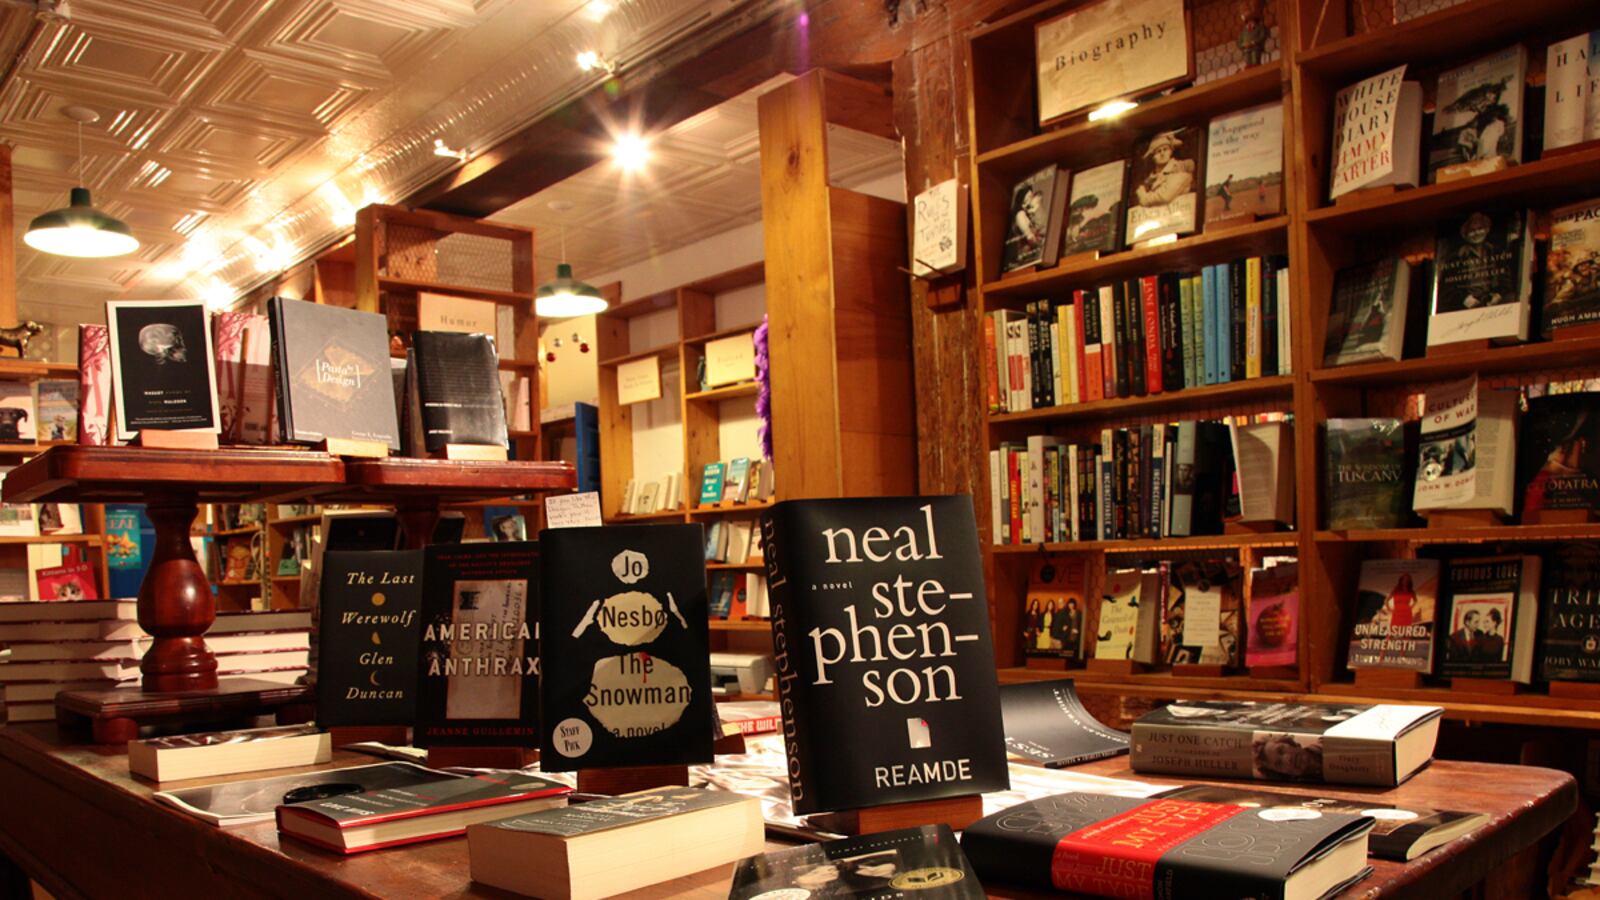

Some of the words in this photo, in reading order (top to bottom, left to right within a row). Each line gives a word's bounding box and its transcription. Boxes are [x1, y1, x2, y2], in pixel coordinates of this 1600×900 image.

[1055, 21, 1167, 72] Biography
[1338, 72, 1401, 107] WHITE
[1337, 88, 1397, 129] HOUSE
[440, 315, 478, 328] Humor
[1434, 413, 1450, 424] OF
[1336, 470, 1402, 482] TUSCANY
[821, 504, 943, 564] neal
[764, 516, 788, 590] neal
[621, 555, 643, 578] Jo
[1031, 562, 1082, 585] LVE
[346, 571, 375, 585] The
[379, 571, 416, 585] Last
[822, 581, 853, 591] novel
[341, 609, 417, 628] Werewolf
[1355, 623, 1427, 638] UNMEASURED
[808, 605, 980, 686] phen-
[1360, 637, 1417, 651] STRENGTH
[358, 652, 394, 666] Glen
[428, 656, 540, 677] ANTHRAX
[618, 654, 654, 676] The
[345, 687, 404, 700] Duncan
[586, 683, 691, 707] Snowman
[862, 663, 963, 708] son
[773, 602, 805, 802] stephenson
[426, 726, 469, 736] JEANNE
[473, 726, 535, 736] GUILLEMIN
[1149, 731, 1175, 744] JUST
[1177, 734, 1200, 745] ONE
[1204, 735, 1242, 749] CATCH
[874, 759, 973, 789] REAMDE
[1151, 755, 1192, 769] JOSEPH
[1195, 759, 1239, 771] HELLER
[1133, 800, 1193, 824] JUST
[1111, 827, 1167, 849] MY
[1152, 801, 1226, 828] TYPE
[1095, 855, 1153, 882] JUST
[1055, 871, 1087, 890] MY
